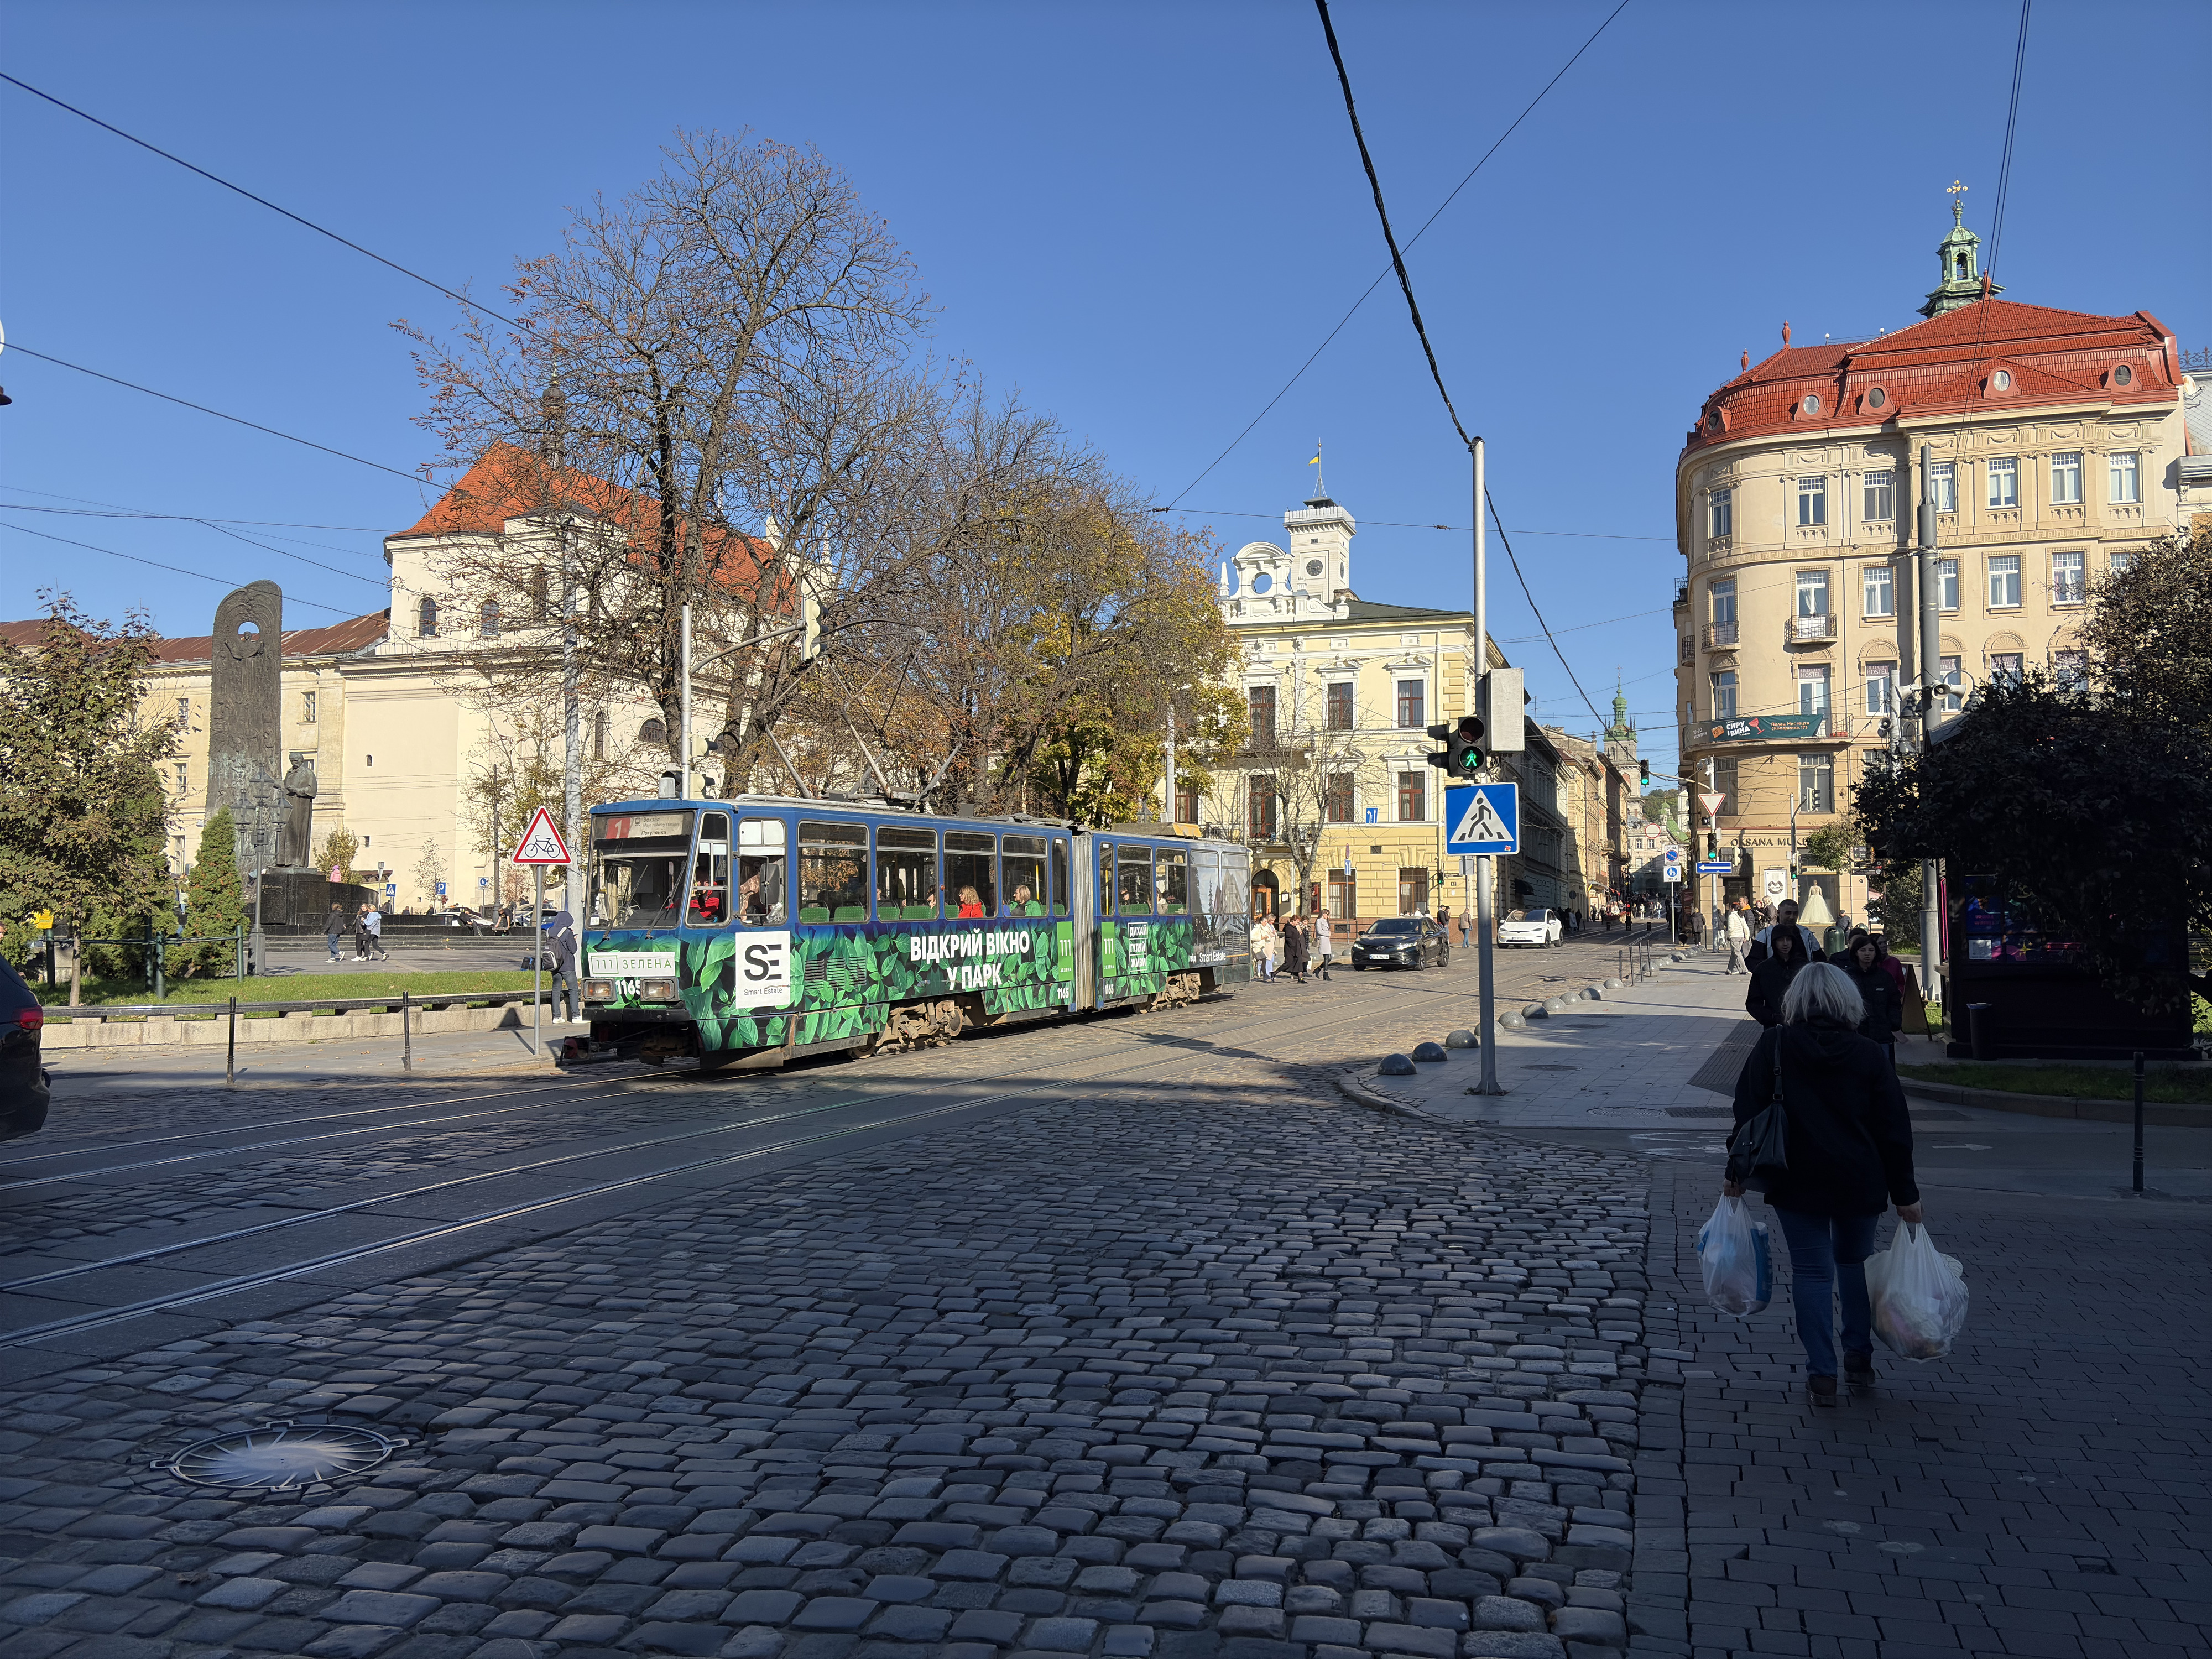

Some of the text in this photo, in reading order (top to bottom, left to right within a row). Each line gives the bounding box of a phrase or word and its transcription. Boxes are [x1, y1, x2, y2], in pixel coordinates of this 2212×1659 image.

[1726, 721, 1745, 729] СИРУ
[1693, 731, 1707, 740] ЖОВТНЯ
[1730, 726, 1750, 737] ВИНА
[615, 820, 622, 839] 1
[1730, 838, 1773, 847] OKSANA
[1129, 925, 1147, 937] ДИХАЙ
[911, 927, 1030, 964] ВІДКРИЙ ВІКНО
[1060, 939, 1071, 956] 111
[1104, 938, 1114, 954] 111
[1130, 941, 1145, 953] ГУЛЯЙ
[744, 944, 782, 981] SE
[1131, 957, 1146, 968] ЖИВИ
[1199, 951, 1226, 963] Smart Estate
[596, 959, 613, 969] 111
[623, 959, 672, 969] ЗЕЛЕНА
[946, 963, 1002, 990] У ПАРК
[1057, 987, 1069, 999] 1165
[1105, 984, 1114, 995] 1165
